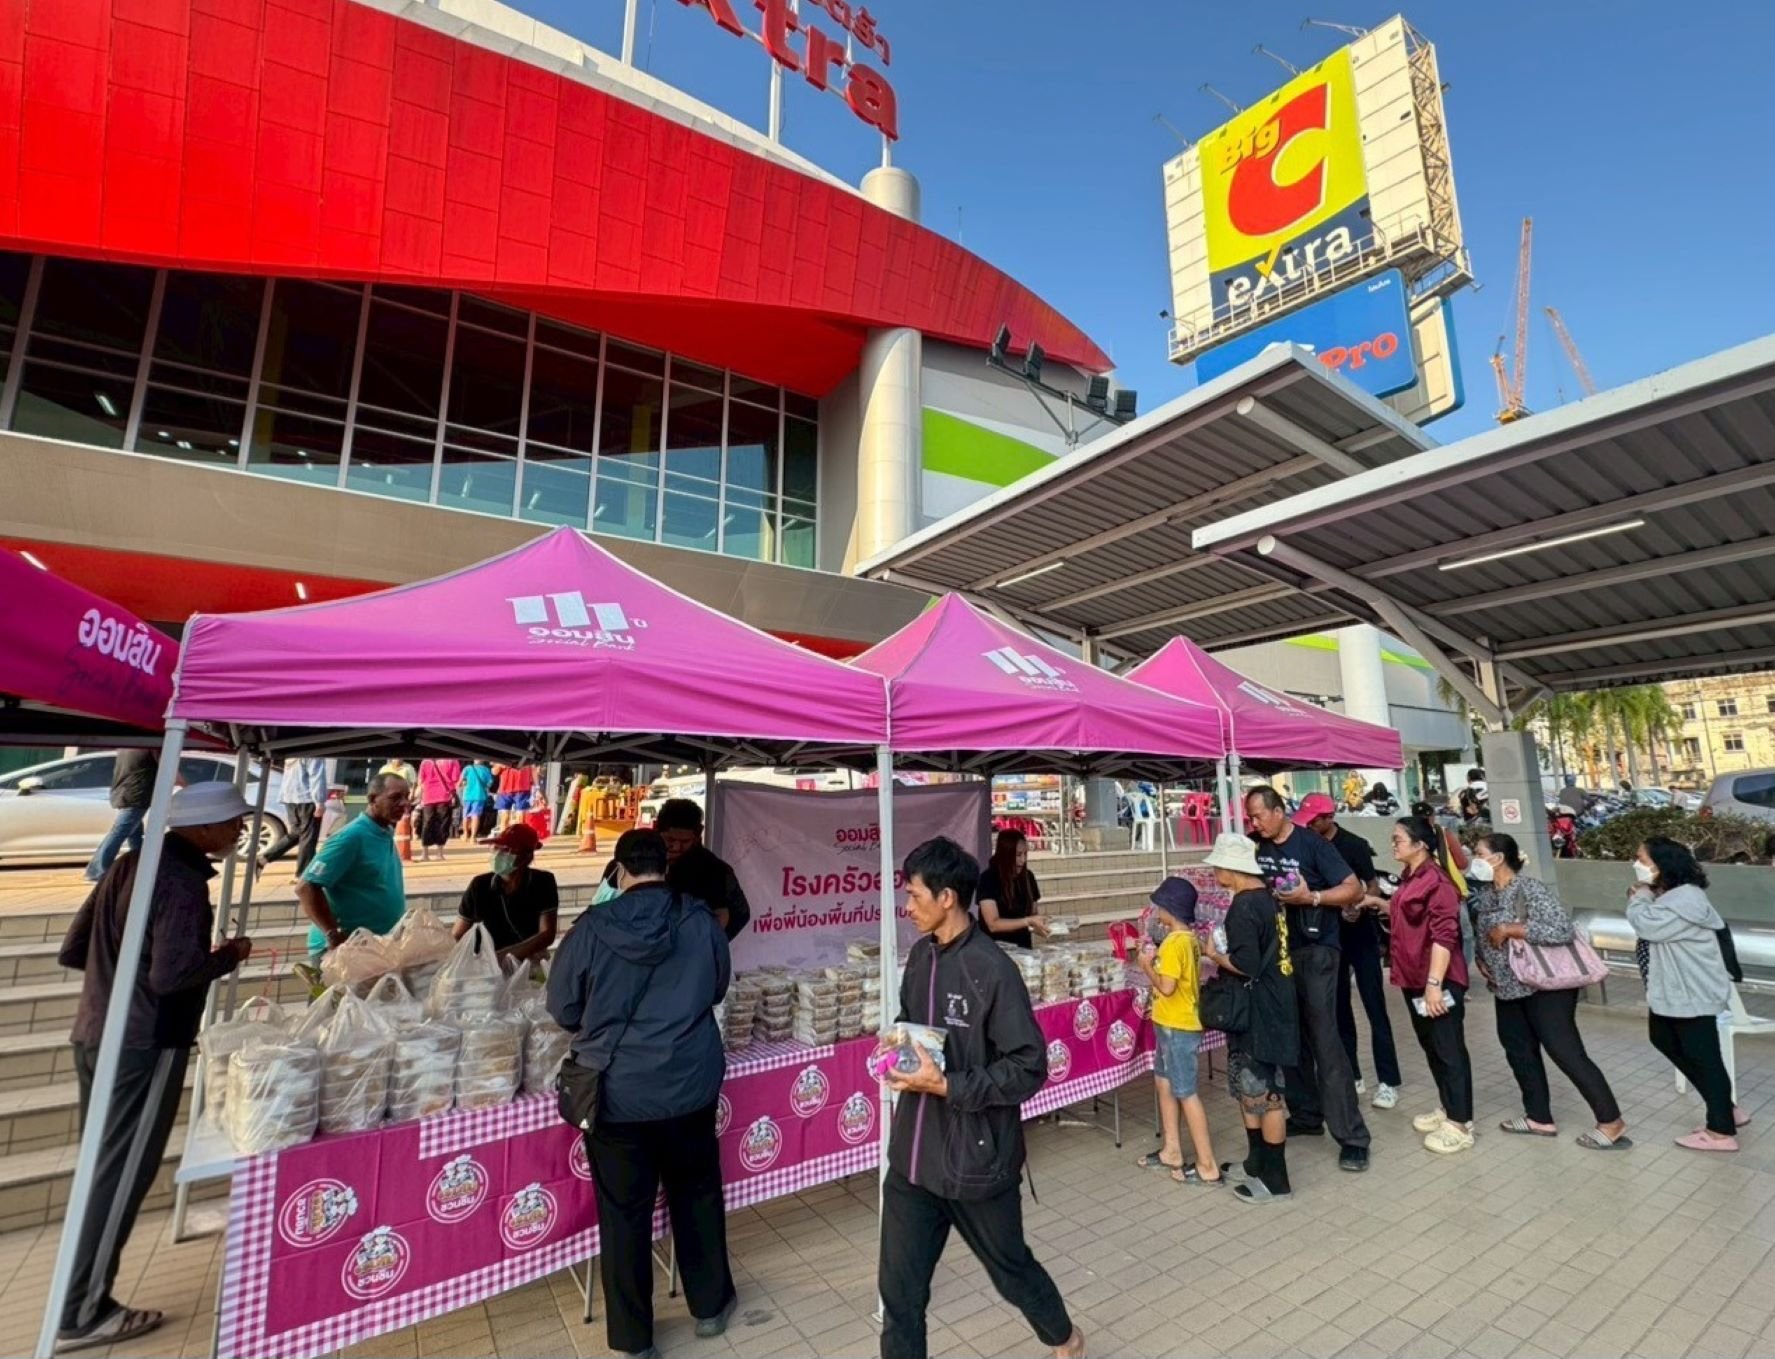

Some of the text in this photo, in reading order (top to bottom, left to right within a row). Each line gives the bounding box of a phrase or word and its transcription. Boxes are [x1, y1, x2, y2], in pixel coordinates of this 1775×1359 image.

[1220, 118, 1282, 176] Big
[1228, 82, 1331, 238] C
[78, 608, 162, 676] ออมสิน
[835, 822, 881, 842] ออมสิ
